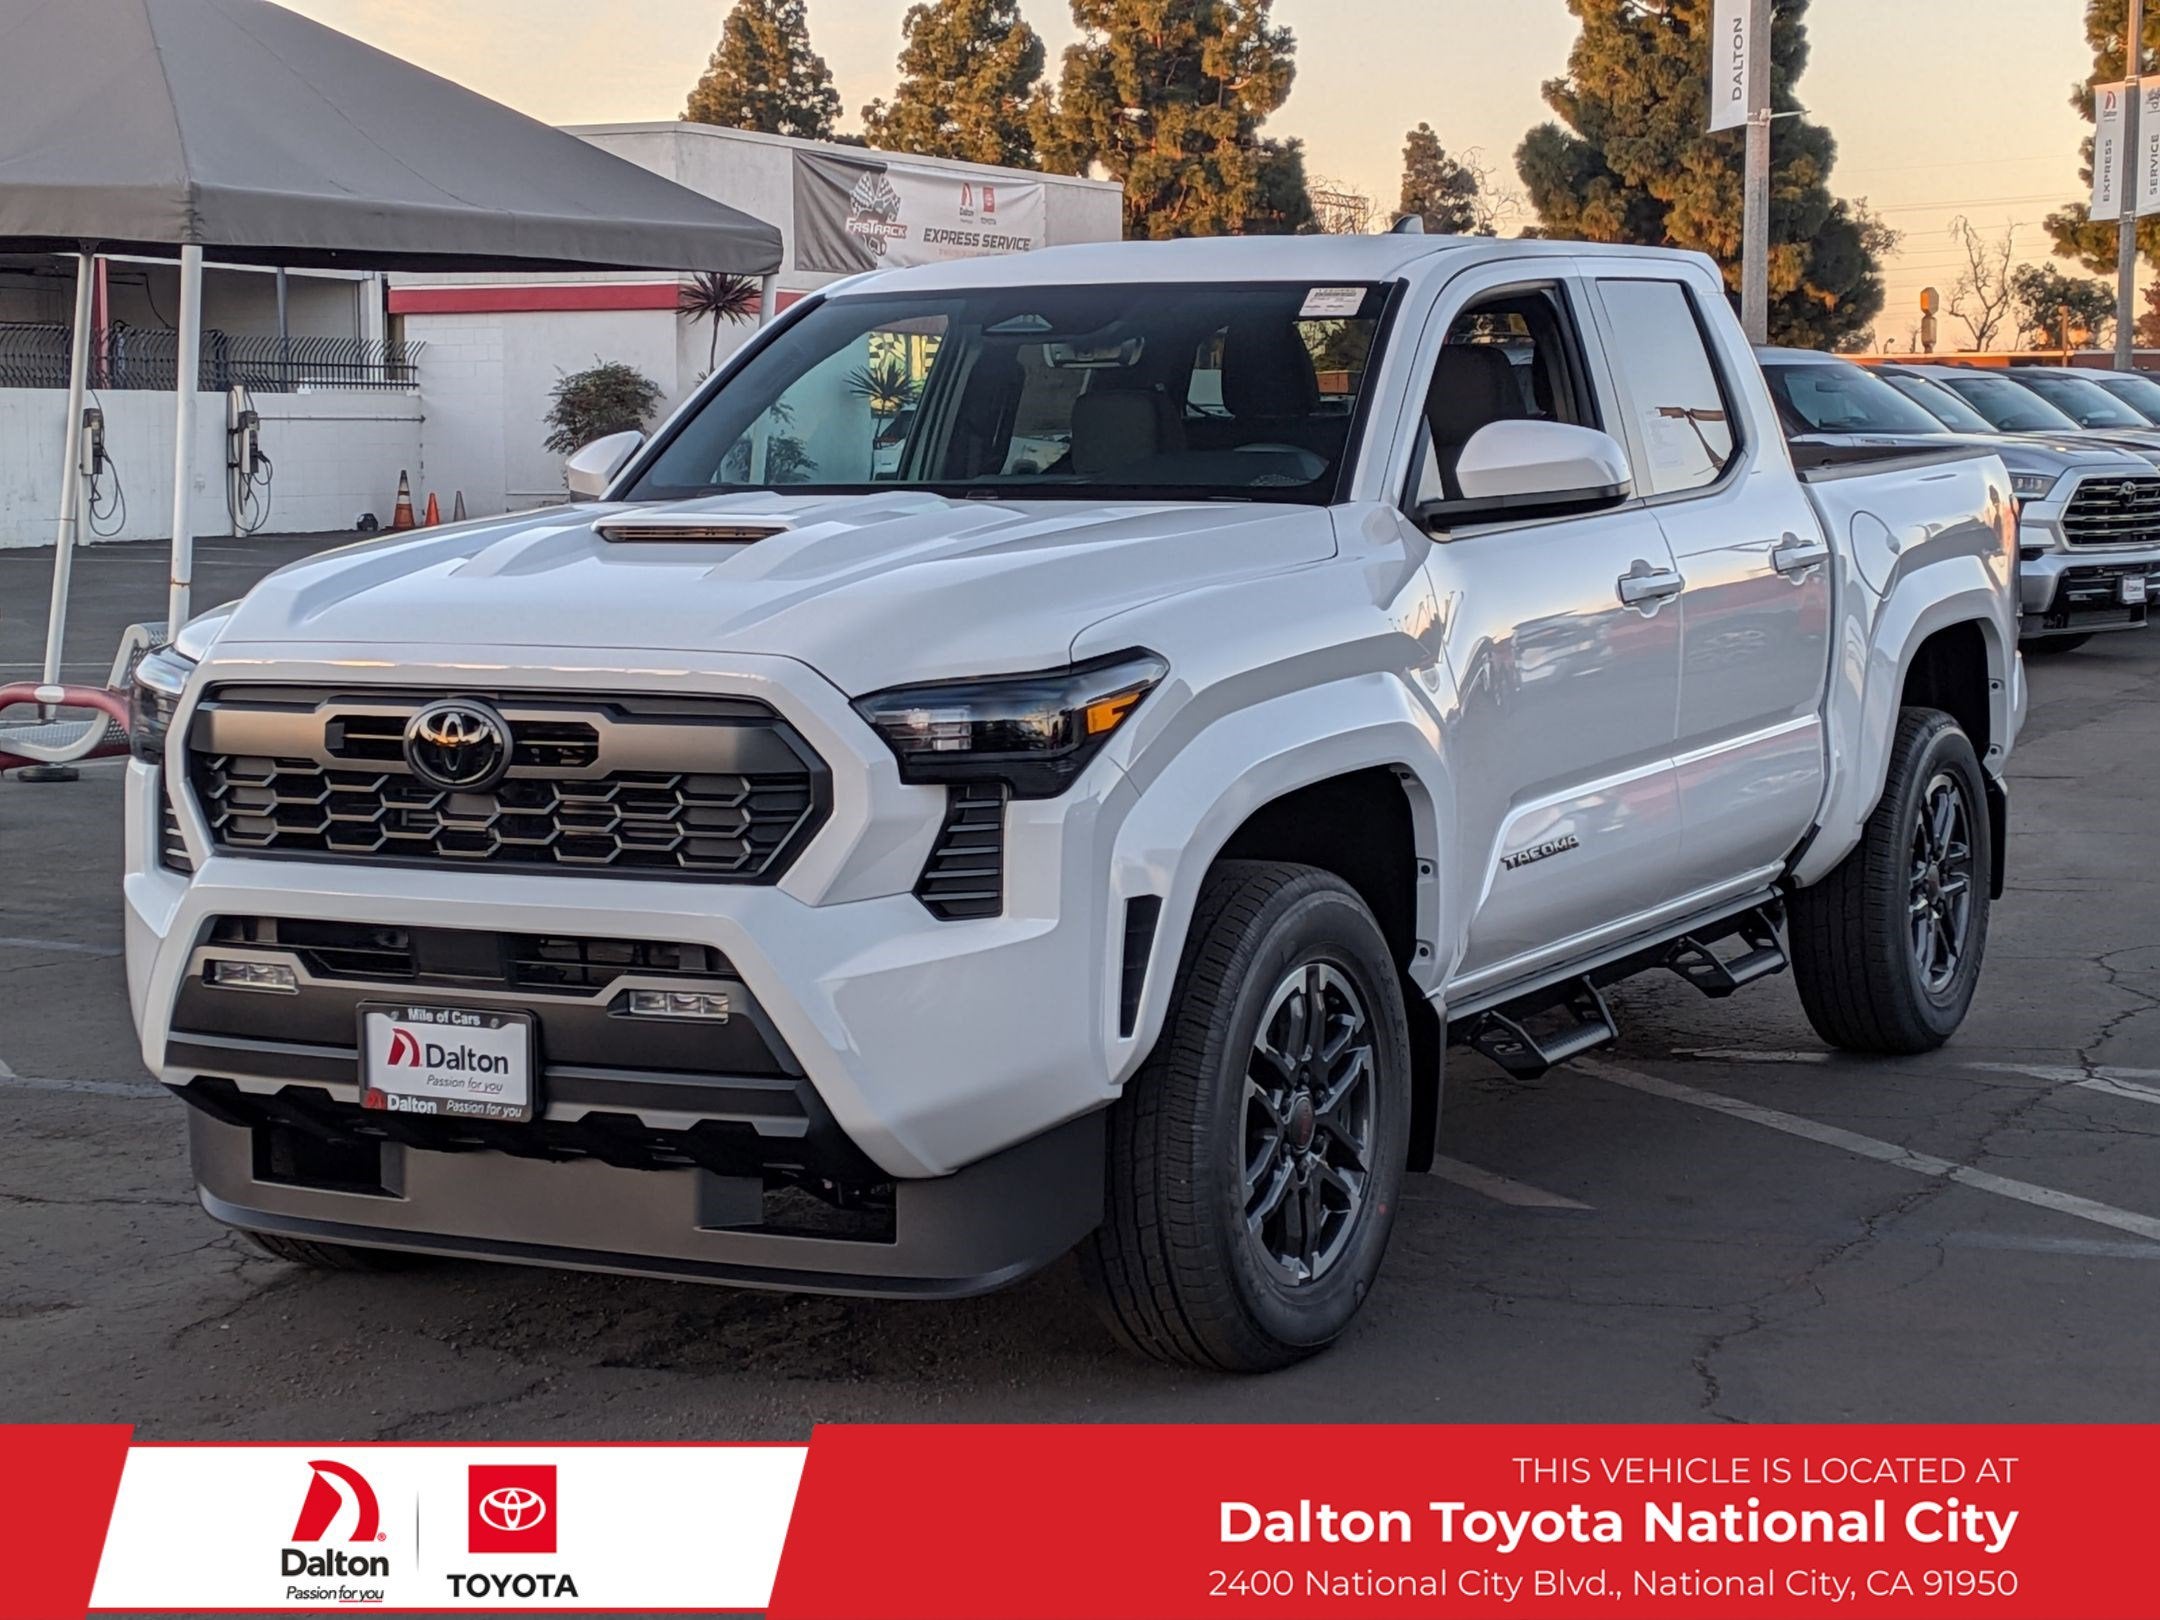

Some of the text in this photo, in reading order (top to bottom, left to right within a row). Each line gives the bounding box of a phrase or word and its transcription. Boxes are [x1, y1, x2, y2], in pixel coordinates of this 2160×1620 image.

[1732, 17, 1744, 101] DALTON
[2103, 139, 2112, 202] EXPRESS
[2150, 134, 2159, 196] SERVICE
[923, 227, 1031, 252] EXPRESS SERVICE
[408, 1008, 481, 1026] Mile of Cars
[426, 1043, 509, 1075] Dalton
[426, 1074, 503, 1093] Passion for you
[387, 1094, 437, 1114] Dalton
[446, 1100, 522, 1118] Passion for you
